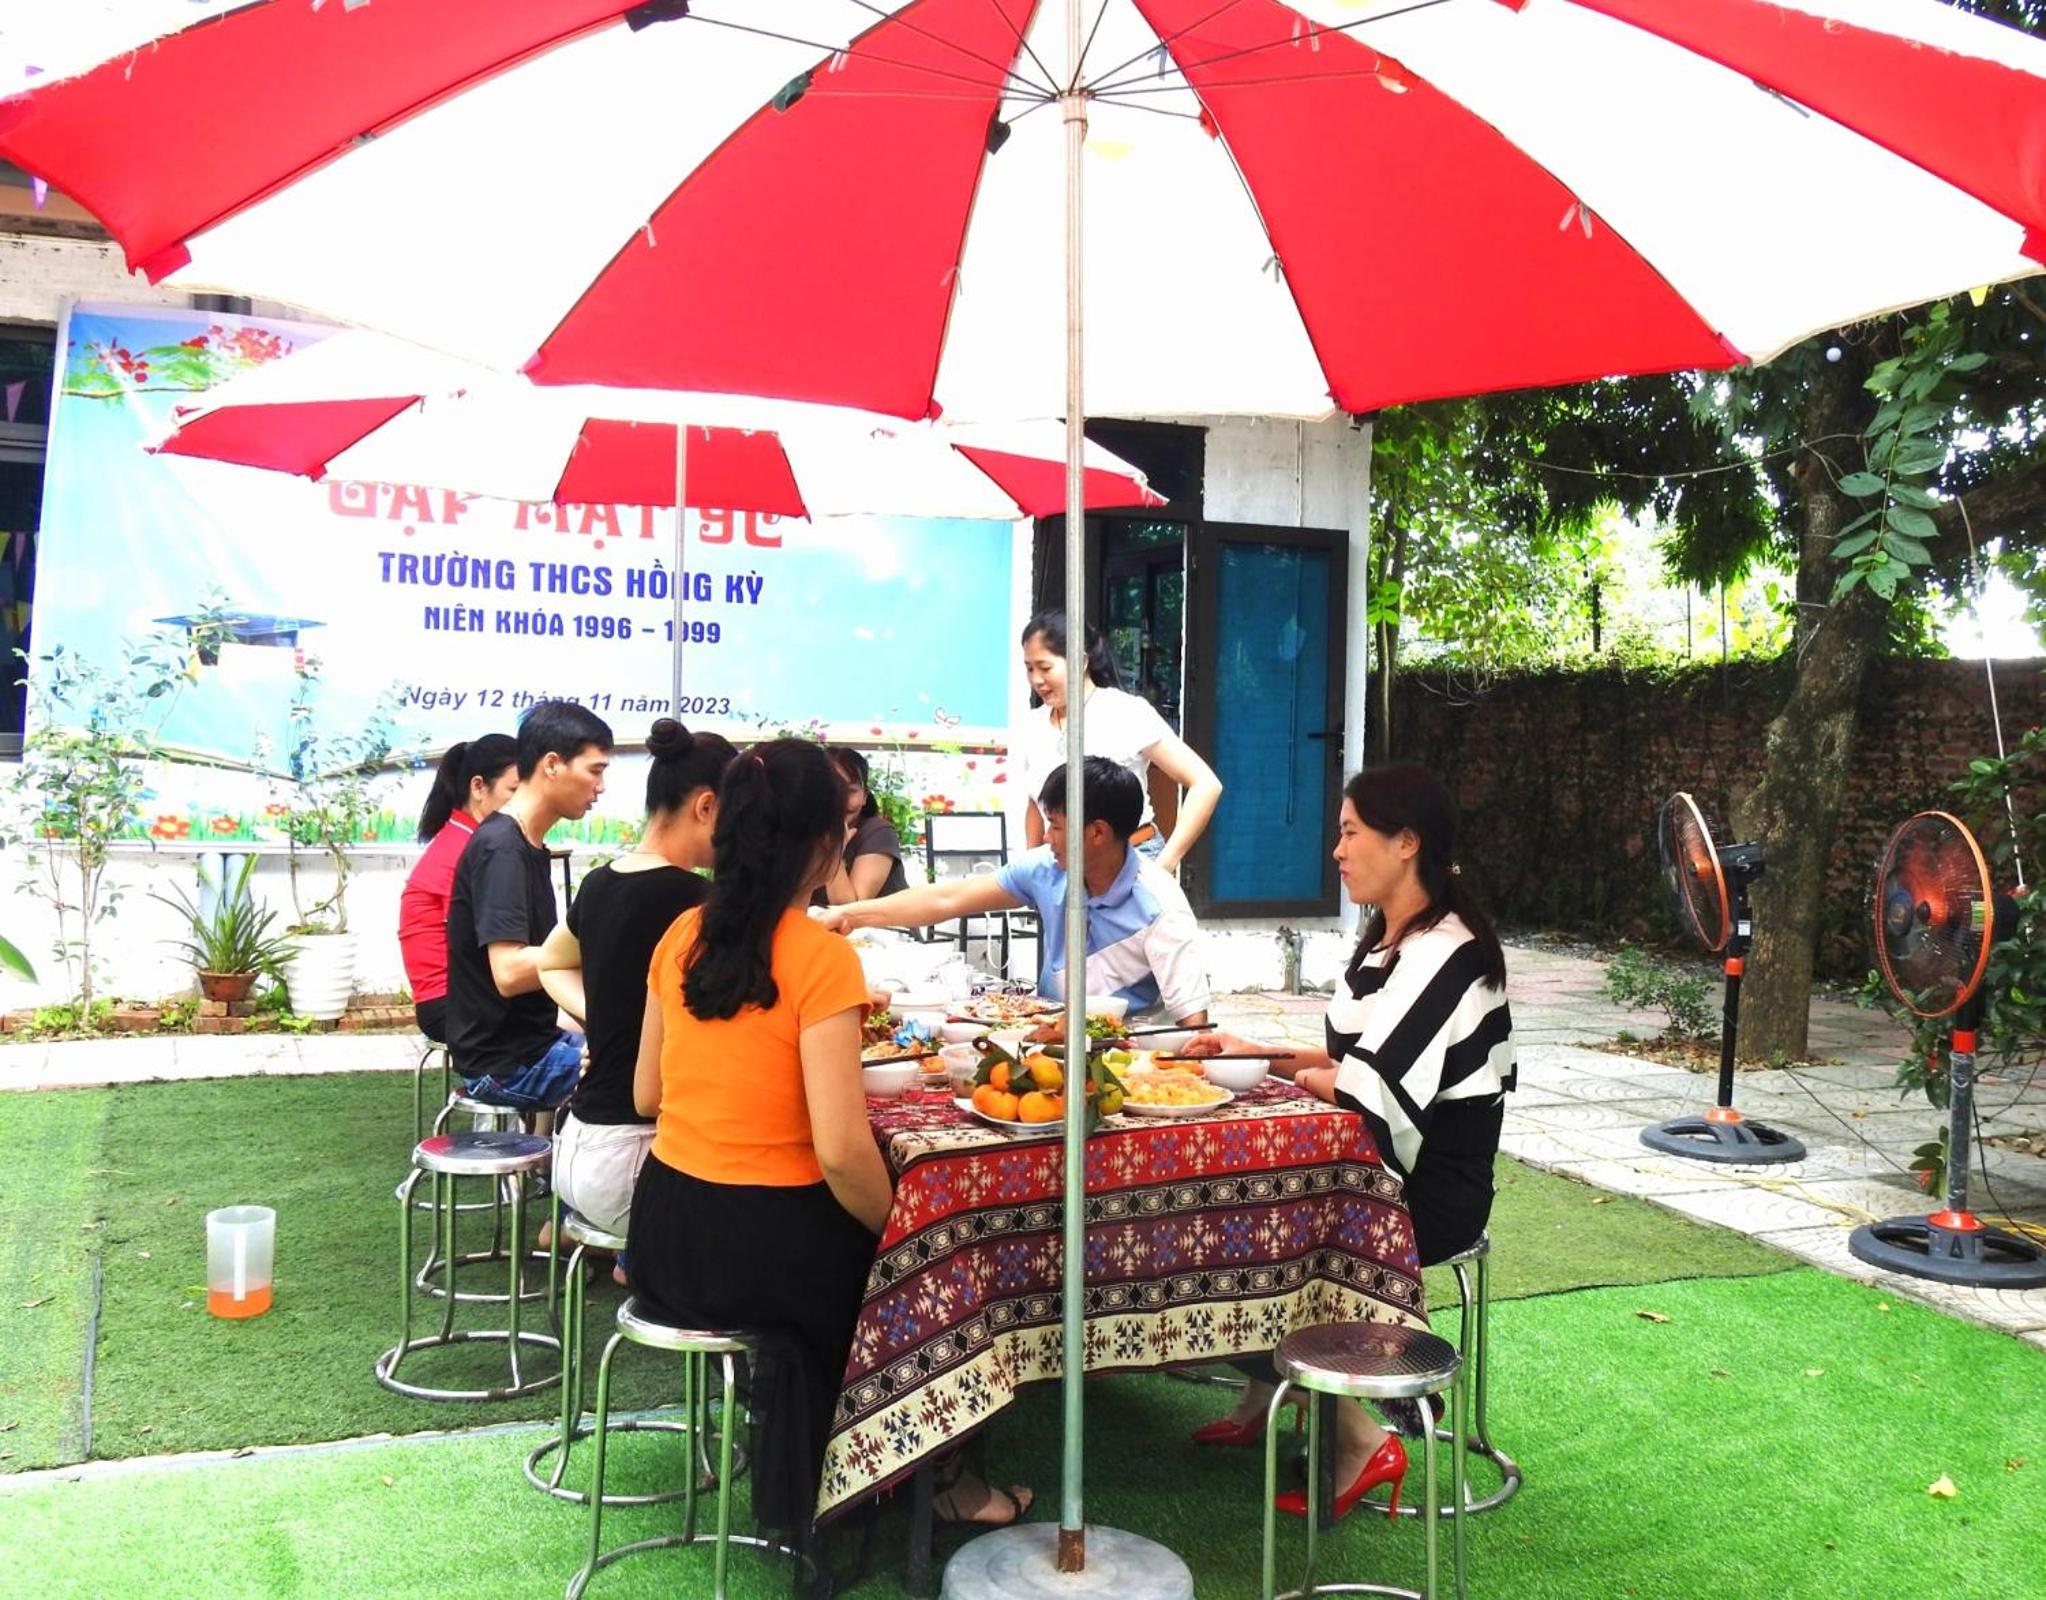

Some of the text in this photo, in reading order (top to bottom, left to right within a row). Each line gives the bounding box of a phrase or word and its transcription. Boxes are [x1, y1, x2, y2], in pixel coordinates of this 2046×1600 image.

[378, 550, 515, 591] TRƯỜNG
[529, 562, 613, 596] THCS
[725, 570, 764, 605] KỲ
[424, 603, 484, 632] NIÊN
[496, 608, 564, 636] KHÓA
[573, 615, 632, 640] 1996
[403, 686, 467, 710] Ngày
[477, 689, 504, 707] 12
[589, 693, 612, 711] 11
[620, 695, 670, 713] năm
[679, 696, 731, 715] 2023
